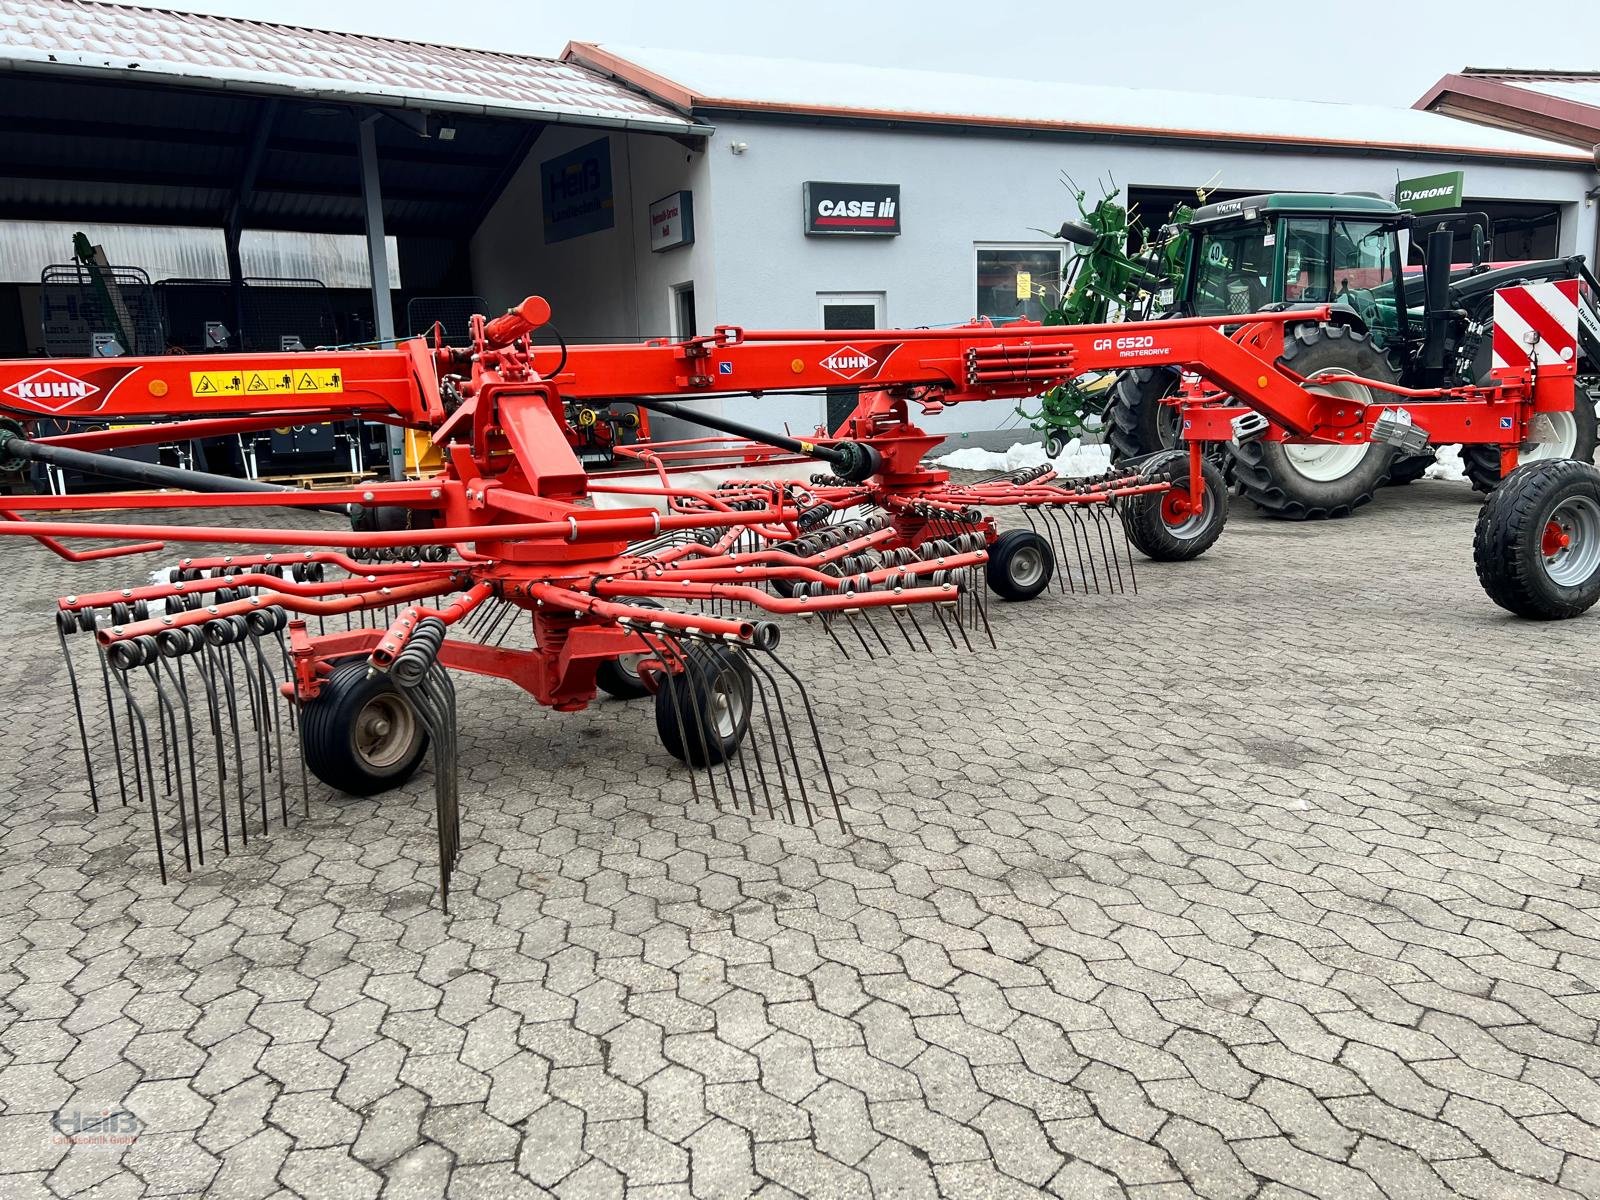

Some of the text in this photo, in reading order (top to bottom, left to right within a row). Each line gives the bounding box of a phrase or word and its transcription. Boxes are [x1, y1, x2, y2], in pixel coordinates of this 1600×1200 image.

[1411, 185, 1455, 201] KRONE
[818, 199, 876, 217] CASE
[1216, 202, 1242, 214] VALTRA
[1210, 245, 1220, 261] 40
[1093, 335, 1154, 351] GA 6520
[1119, 347, 1170, 358] MASTERDRIVE
[827, 356, 869, 369] KUHN
[17, 382, 86, 398] KUHN
